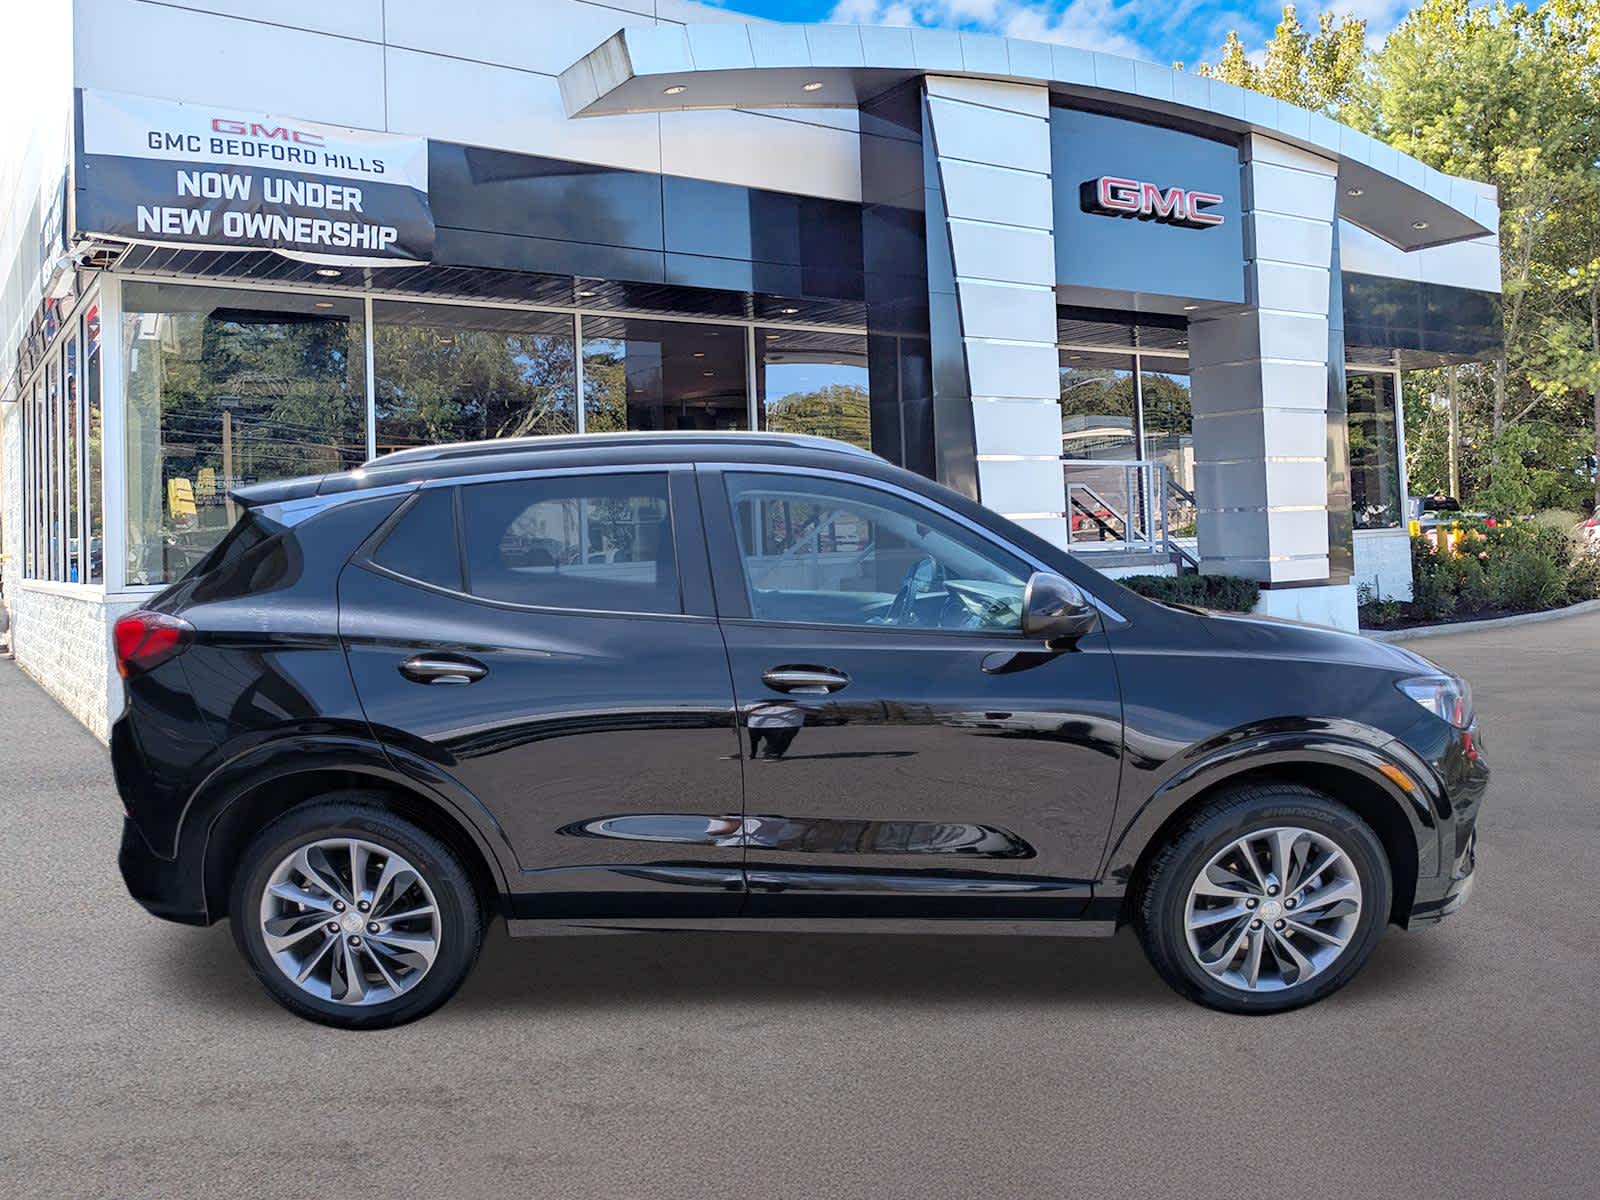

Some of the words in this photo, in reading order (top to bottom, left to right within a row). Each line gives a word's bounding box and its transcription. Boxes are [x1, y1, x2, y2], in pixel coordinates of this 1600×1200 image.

[148, 131, 201, 152] GMC
[210, 138, 317, 165] BEDFORD
[325, 154, 385, 174] HILLS
[211, 118, 326, 148] GMC
[177, 170, 252, 201] NOW
[263, 176, 364, 213] UNDER
[1098, 176, 1224, 224] GMC
[136, 205, 212, 236] NEW
[223, 211, 398, 250] OWNERSHIP
